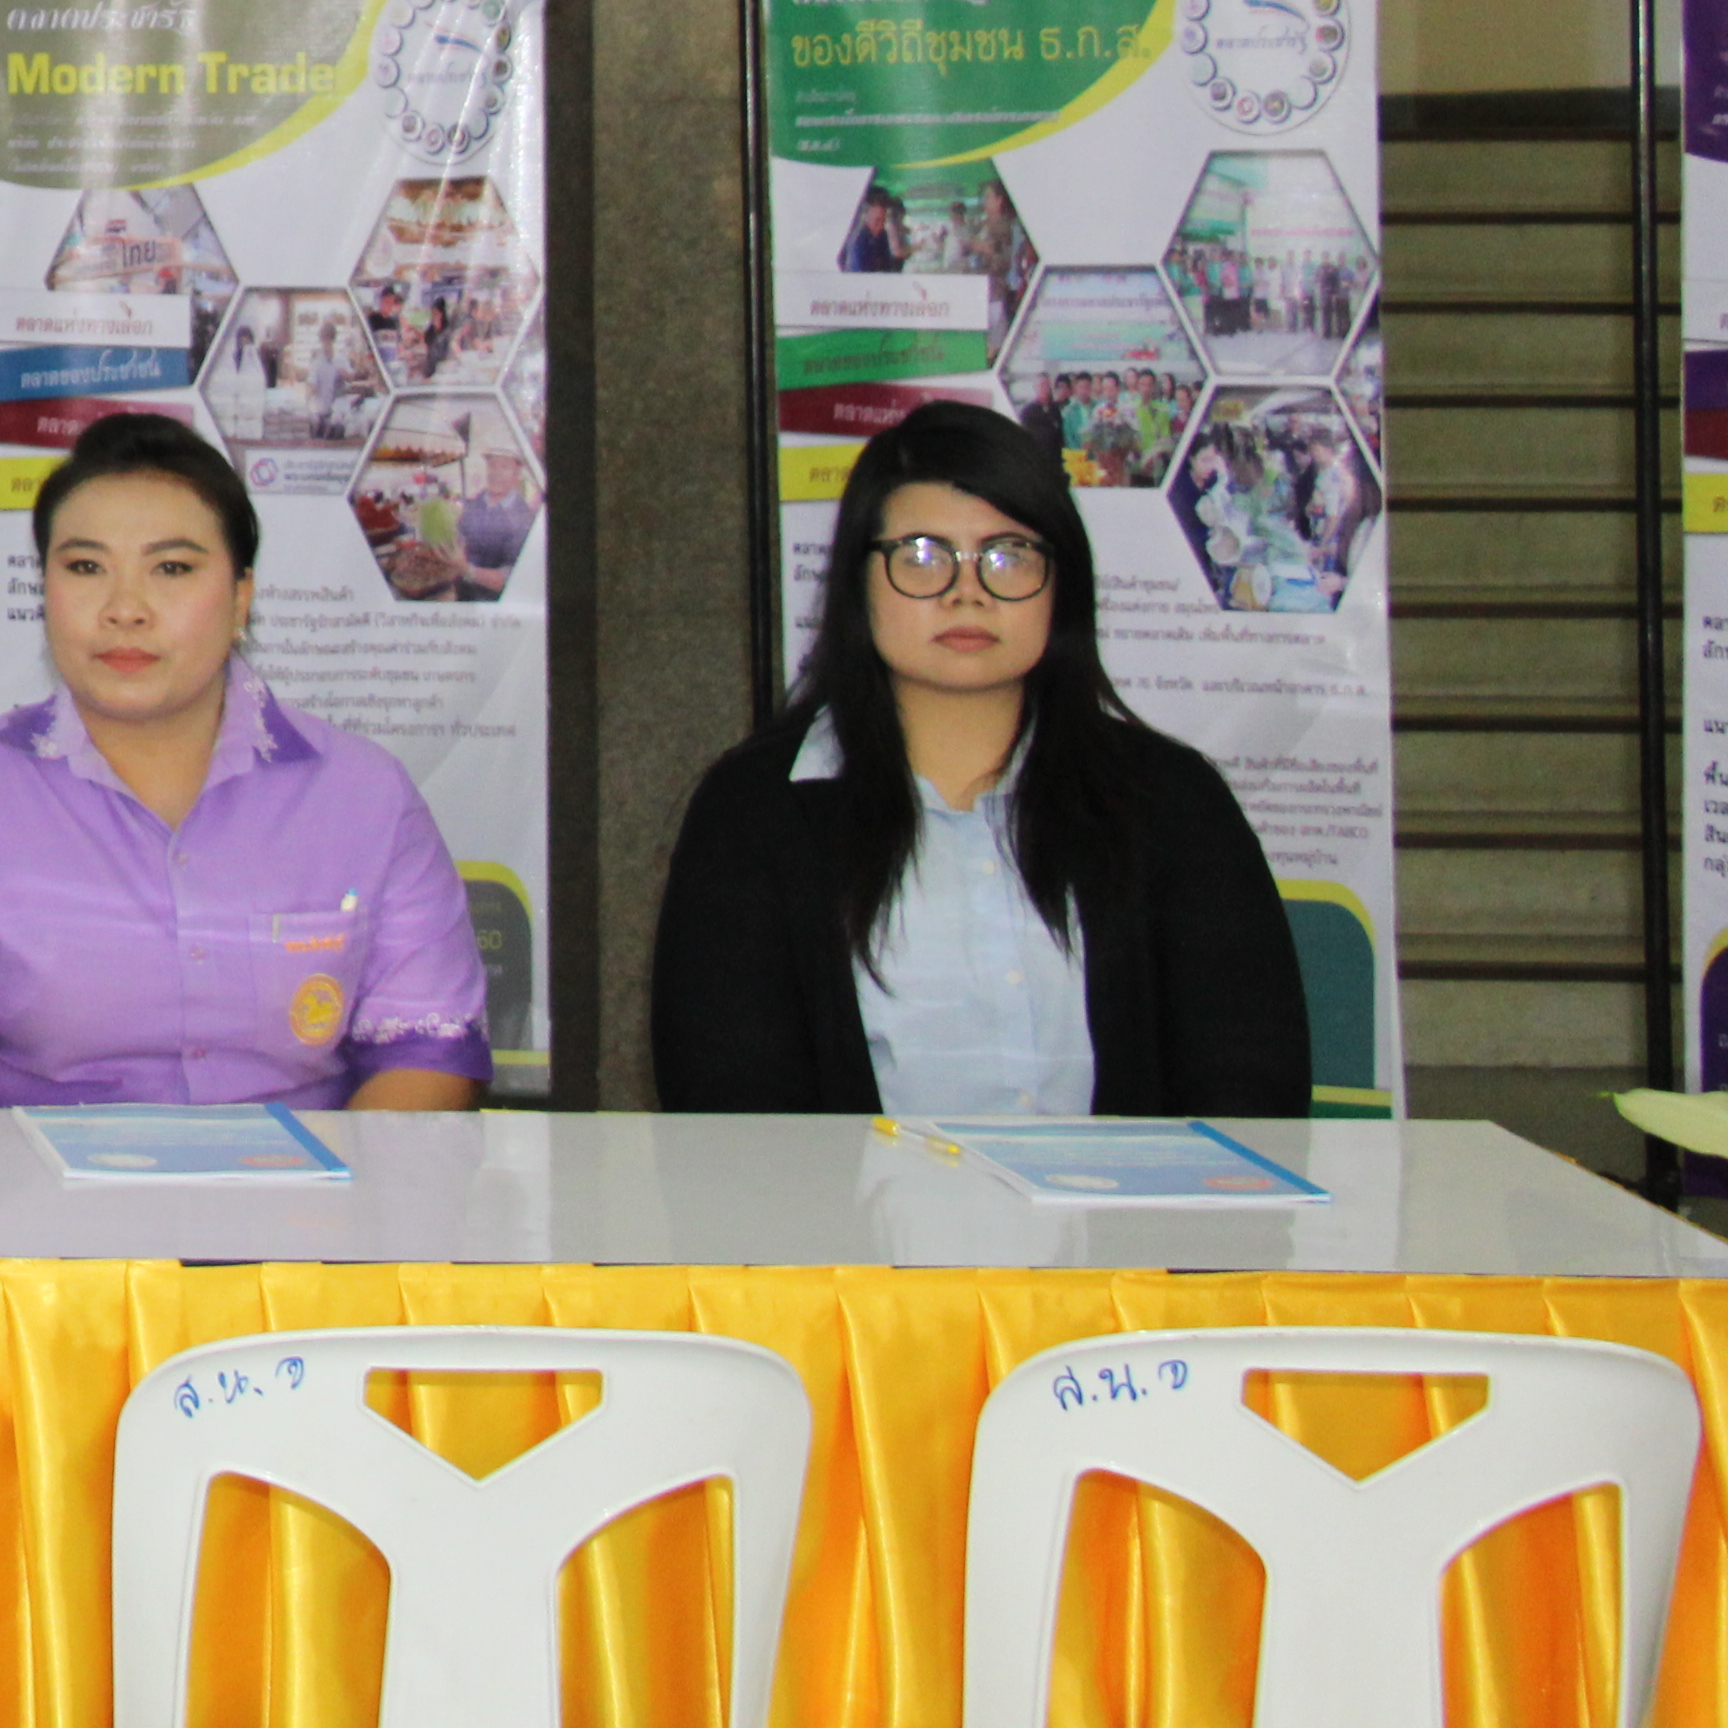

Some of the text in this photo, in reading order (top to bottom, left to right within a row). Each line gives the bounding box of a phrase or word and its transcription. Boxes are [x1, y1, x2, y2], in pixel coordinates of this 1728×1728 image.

[8, 50, 338, 95] Modern Trade
[791, 19, 1152, 78] ของดีวิถีชุมชน ธ.ก.ส.
